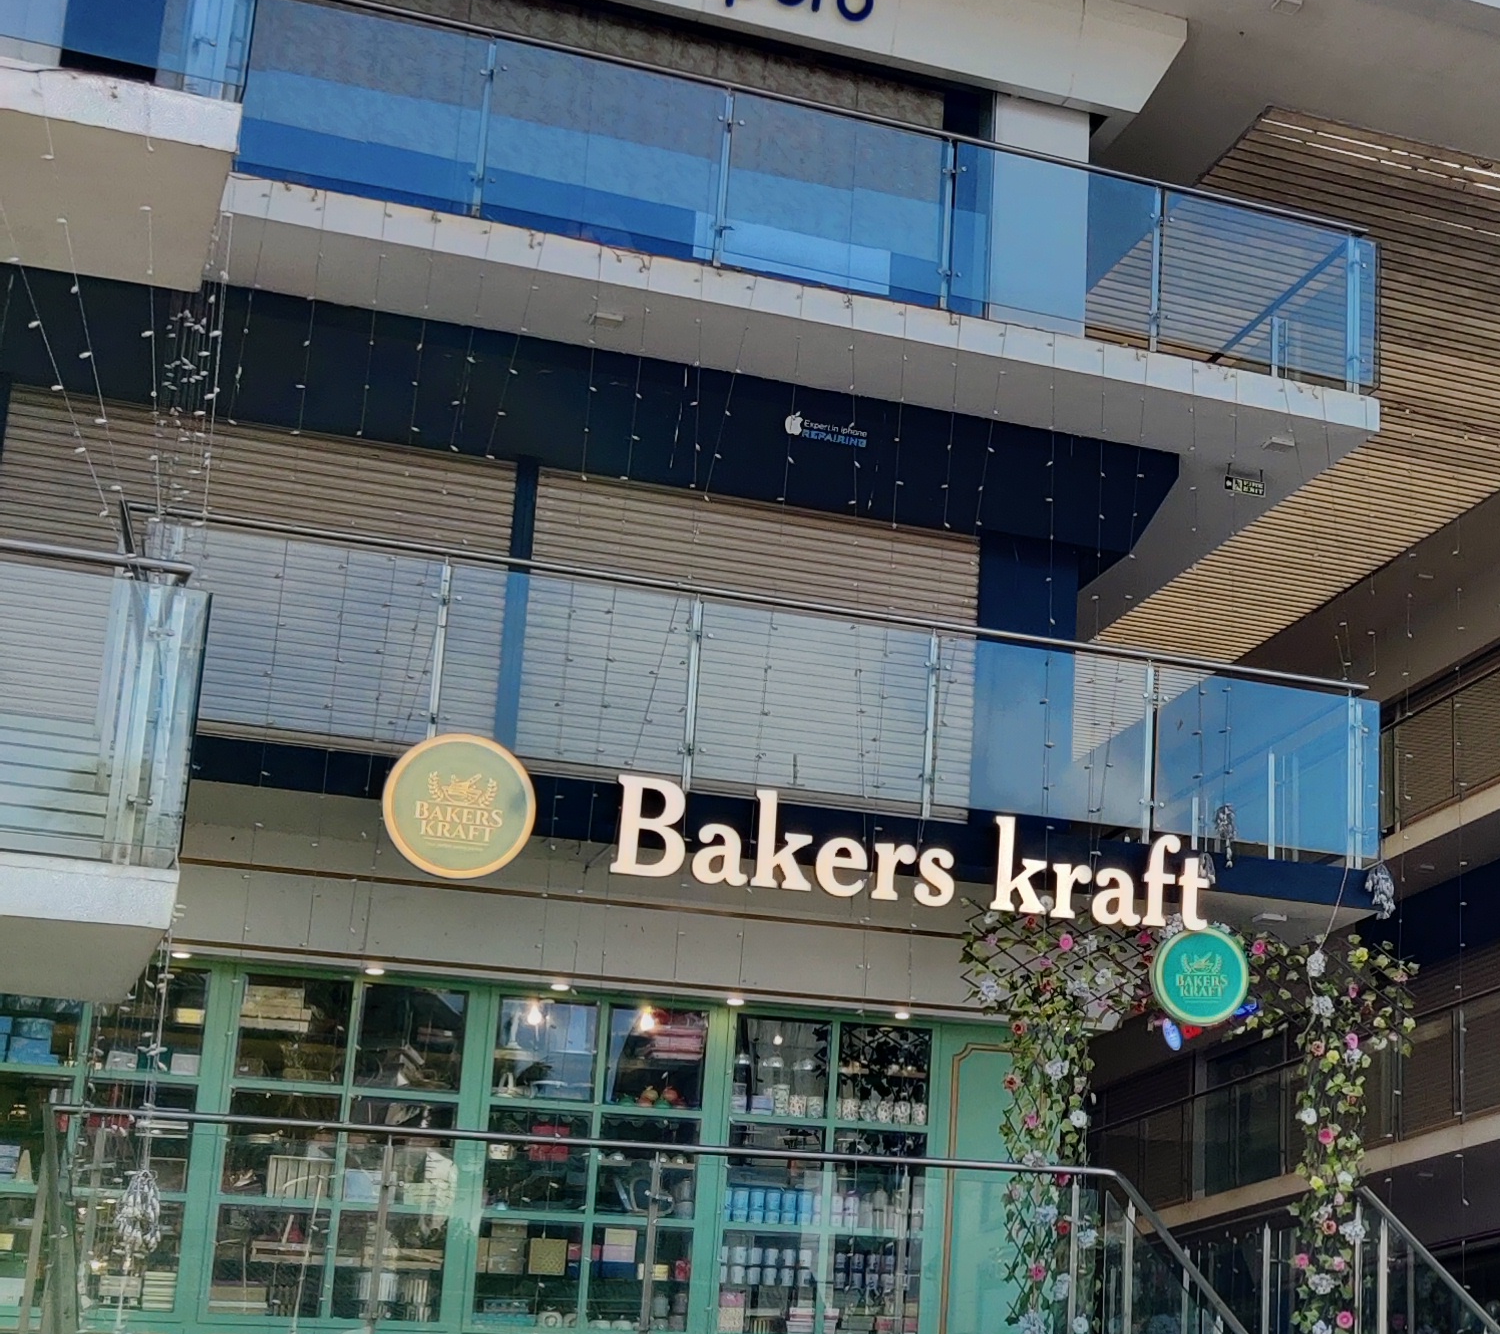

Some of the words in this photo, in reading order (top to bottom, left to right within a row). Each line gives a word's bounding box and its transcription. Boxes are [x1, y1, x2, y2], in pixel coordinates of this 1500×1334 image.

[802, 428, 867, 448] REPAIRING
[414, 800, 503, 828] BAKERS
[420, 820, 495, 843] KRAFT
[609, 774, 956, 909] Bakers
[988, 815, 1211, 932] kraft
[1175, 973, 1229, 987] BAKERS
[1180, 985, 1224, 998] KRAFT
